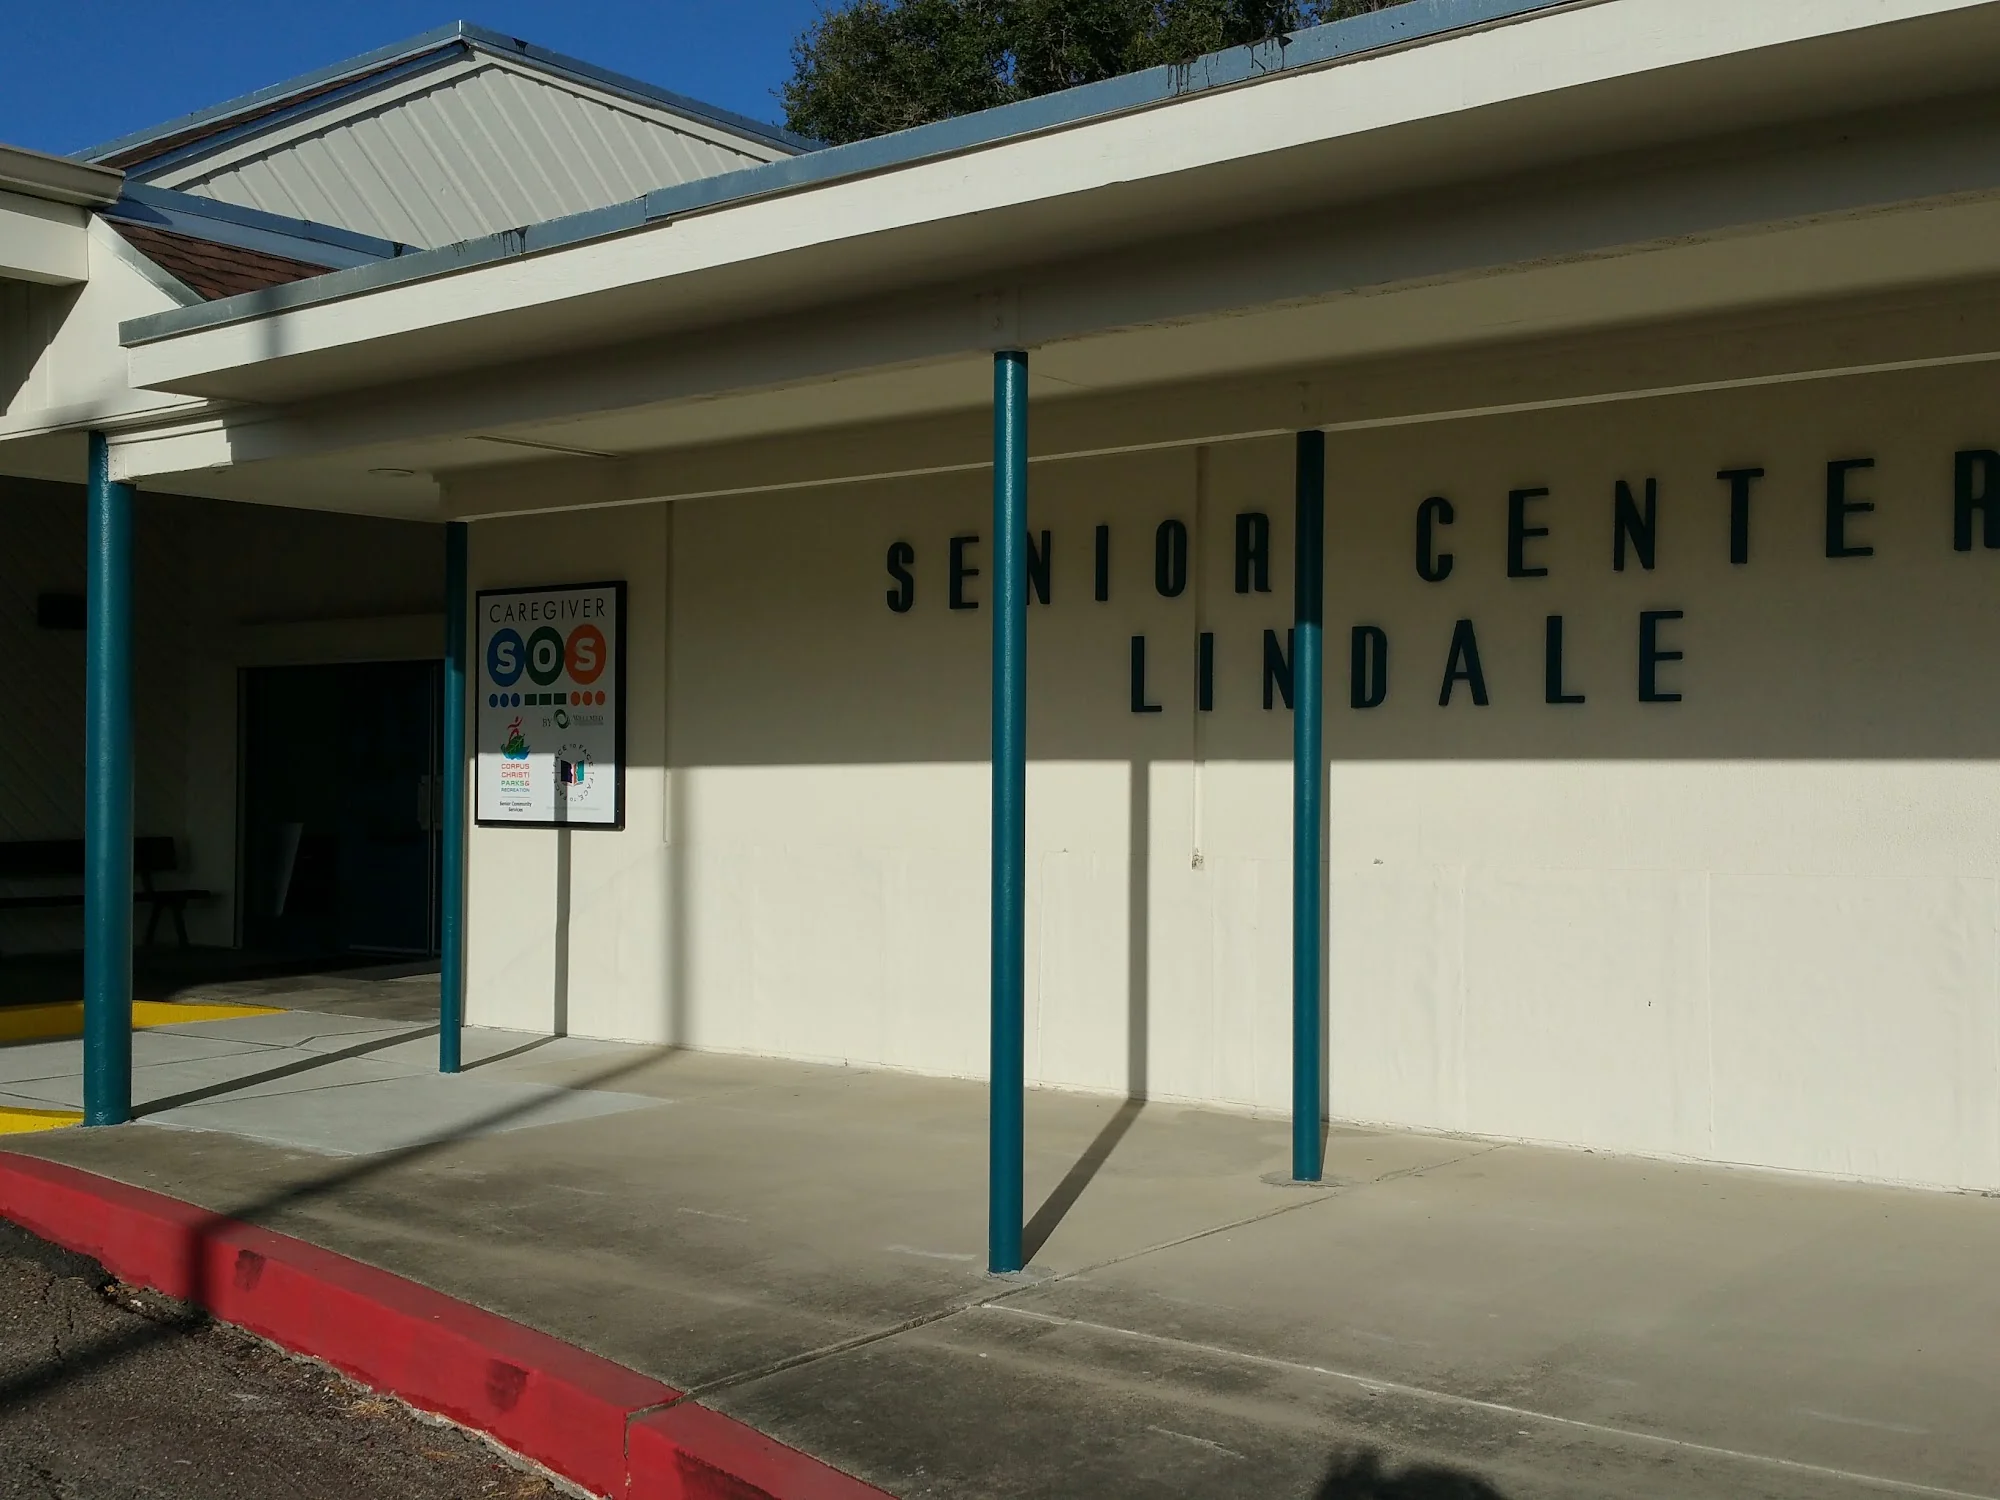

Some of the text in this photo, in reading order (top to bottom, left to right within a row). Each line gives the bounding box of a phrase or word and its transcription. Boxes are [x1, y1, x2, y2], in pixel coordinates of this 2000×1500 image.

[886, 449, 2000, 613] SENIOR CENTER
[489, 597, 605, 622] CAREGIVER
[494, 635, 598, 676] SOS
[1130, 610, 1685, 713] LINDALE
[542, 717, 553, 728] BY
